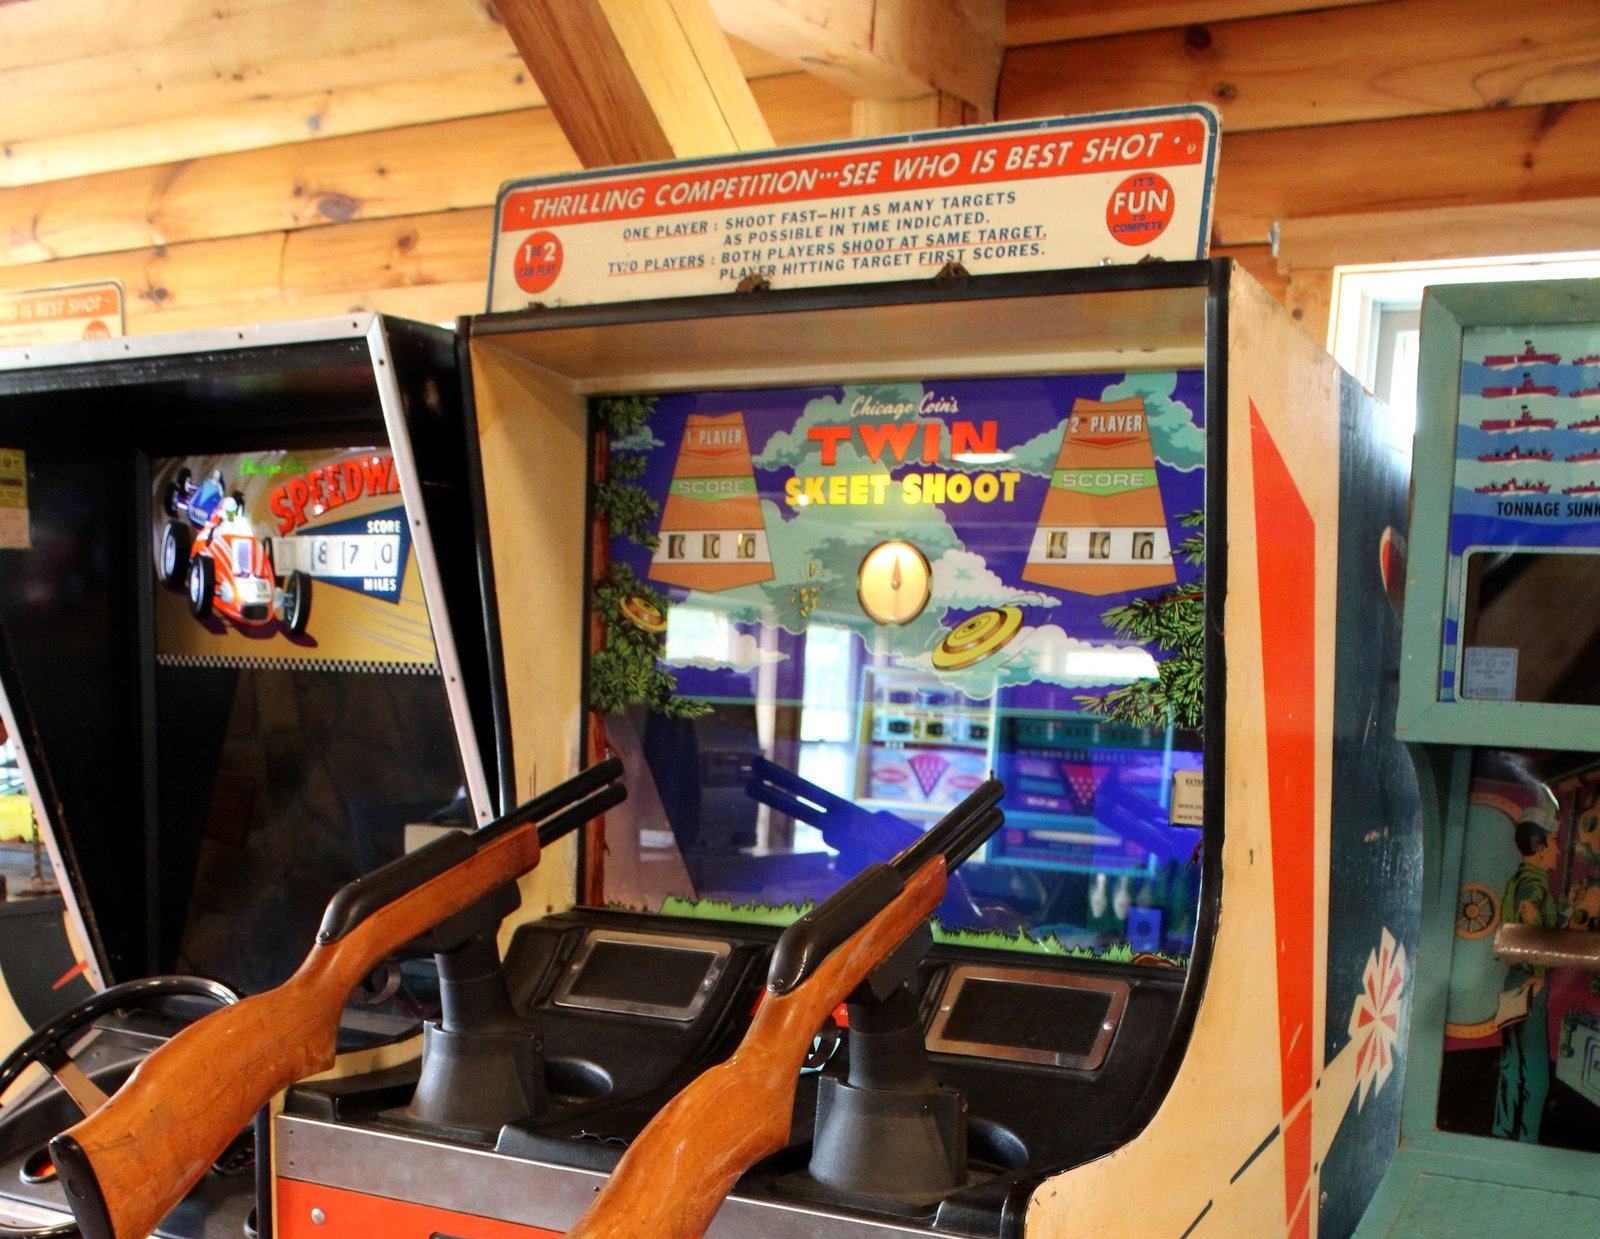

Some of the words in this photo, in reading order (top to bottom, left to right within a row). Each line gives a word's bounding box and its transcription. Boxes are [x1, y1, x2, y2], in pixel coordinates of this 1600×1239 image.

[531, 187, 646, 220] THRILLING
[893, 152, 961, 182] WHO
[970, 148, 998, 174] IS
[1004, 140, 1073, 171] BEST
[1081, 131, 1164, 164] SHOT
[1132, 176, 1155, 188] IT'S
[1113, 188, 1169, 215] FUN
[623, 226, 650, 240] ONE
[656, 220, 709, 237] PLAYER
[726, 213, 775, 230] SHOOT
[861, 203, 881, 217] AS
[888, 199, 934, 215] MANY
[942, 191, 1016, 209] TARGETS
[1132, 213, 1146, 222] TO
[723, 233, 742, 246] AS
[748, 226, 824, 244] POSSIBLE
[829, 223, 845, 237] IN
[852, 219, 890, 234] TIME
[896, 211, 990, 231] INDICATED.
[1112, 220, 1164, 233] COMPETE
[525, 243, 533, 264] 1
[543, 240, 557, 262] 2
[608, 260, 638, 274] TWO
[644, 254, 705, 271] PLAYERS
[721, 249, 761, 264] BOTH
[767, 243, 836, 260] PLAYERS
[842, 236, 895, 255] SHOOT
[900, 234, 919, 249] AT
[926, 230, 971, 247] SAME
[719, 264, 777, 280] PLAYER
[782, 258, 845, 275] HITTING
[852, 252, 912, 270] TARGET
[918, 248, 966, 264] FIRST
[973, 242, 1045, 261] SCORES.
[68, 295, 103, 315] SHOT
[850, 394, 914, 420] Chicago
[918, 391, 959, 415] Coin's
[1090, 414, 1143, 433] PLAYER
[699, 428, 743, 447] PLAYER
[807, 420, 998, 466] TWIN
[678, 479, 745, 495] SCORE
[784, 472, 891, 507] SKEET
[902, 471, 1021, 505] SHOOT
[1062, 472, 1145, 487] SCORE
[1497, 502, 1561, 517] TONNAGE
[366, 519, 402, 535] SCORE
[363, 577, 397, 592] MILES
